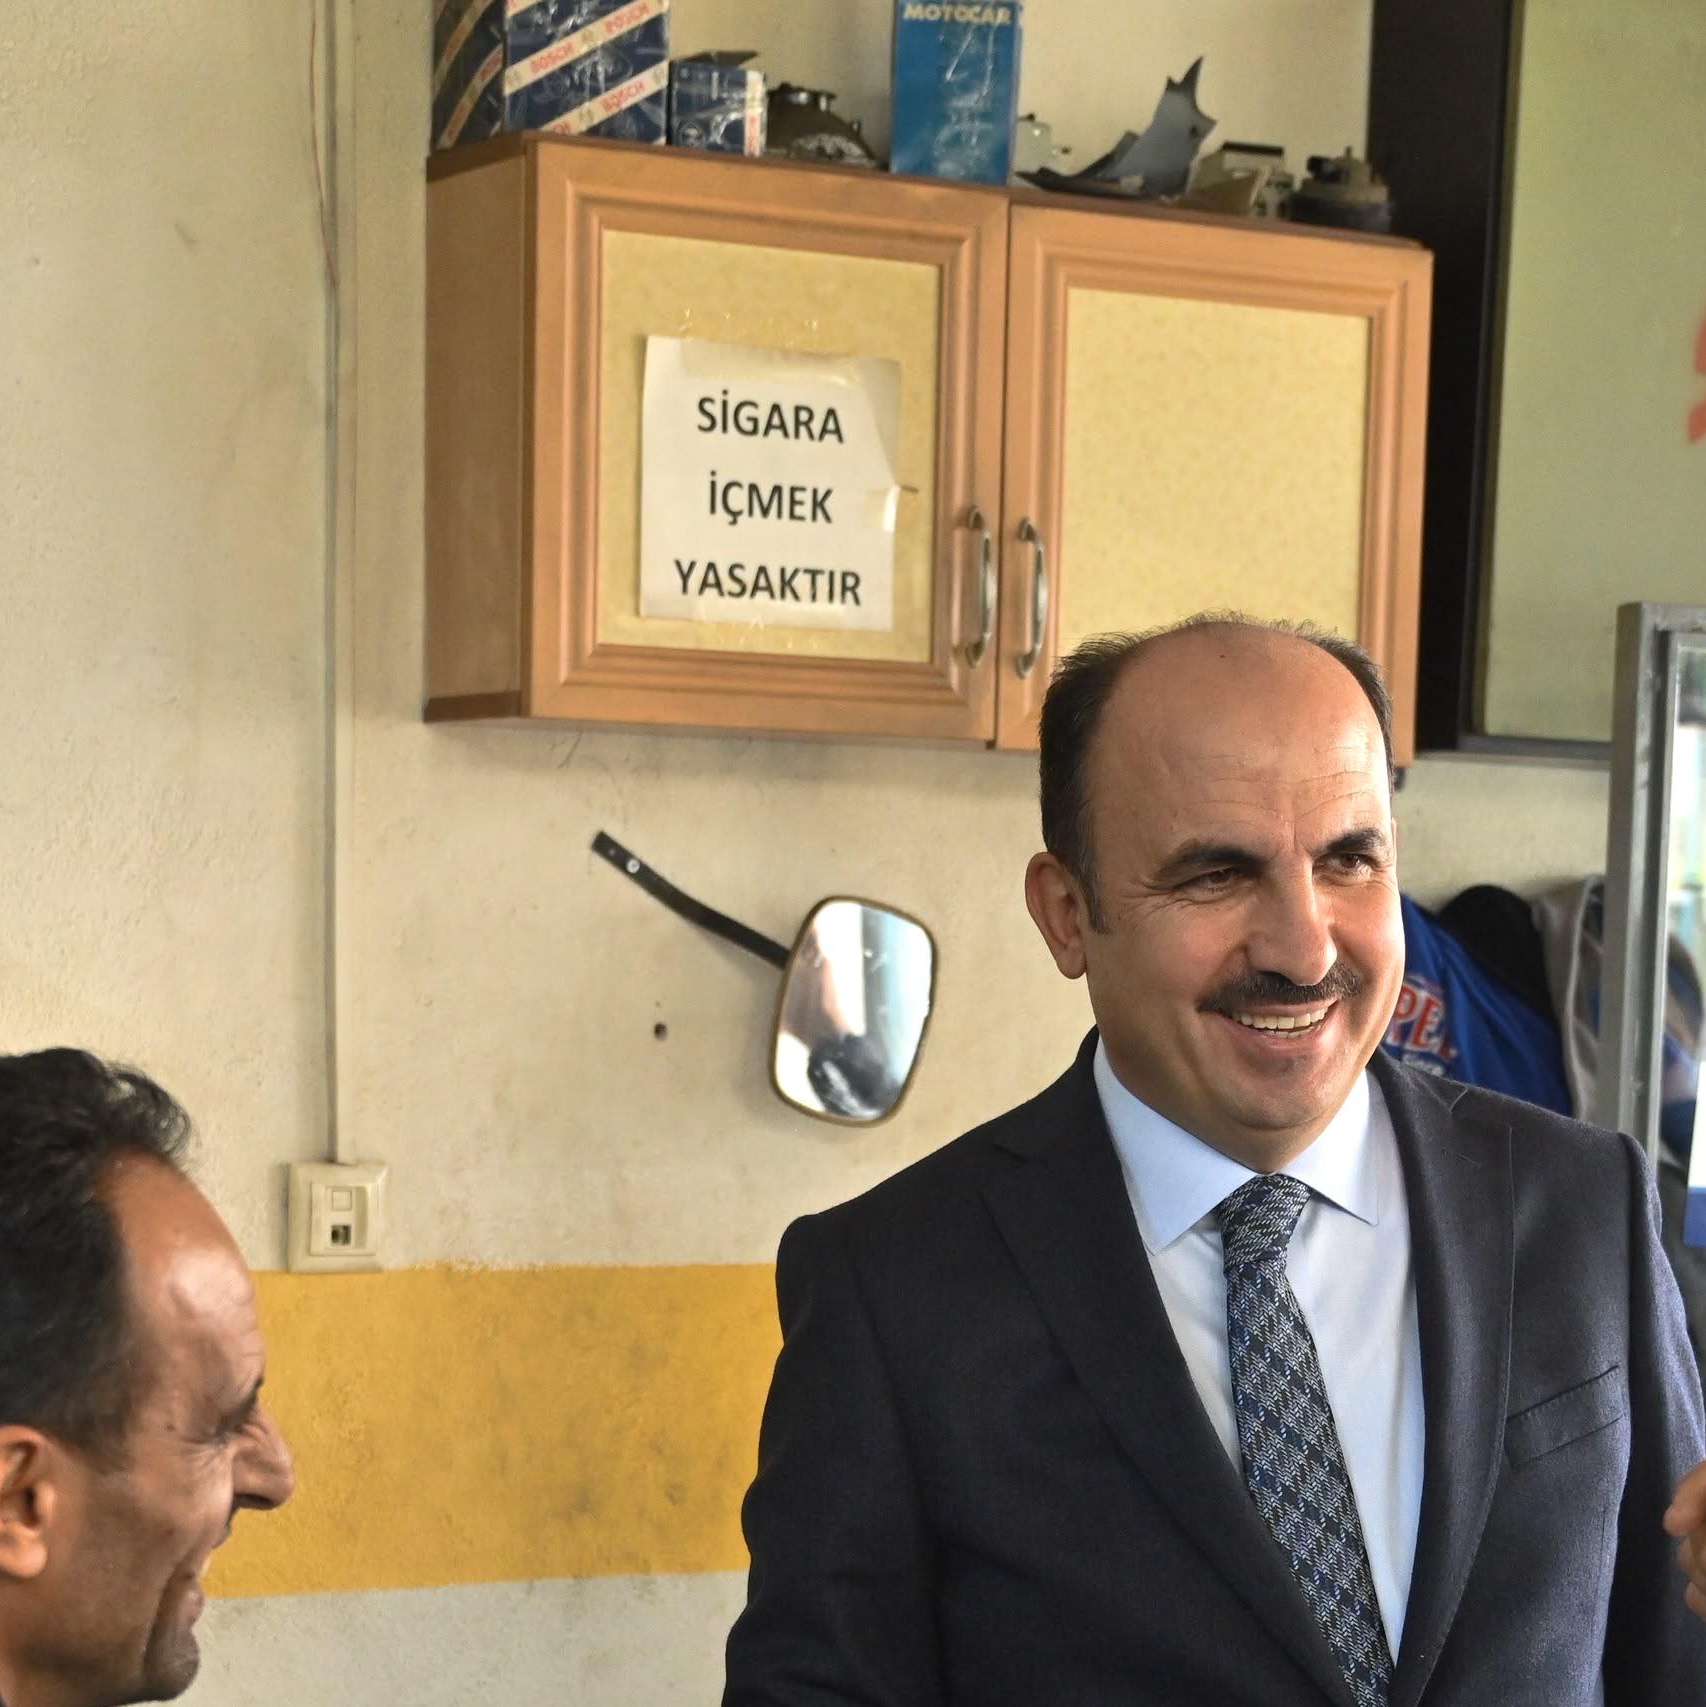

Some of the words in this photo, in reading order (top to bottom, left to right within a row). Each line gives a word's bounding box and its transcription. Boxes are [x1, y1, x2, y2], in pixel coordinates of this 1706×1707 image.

[696, 388, 845, 444] SİGARA
[709, 470, 834, 526] İÇMEK
[674, 558, 862, 607] YASAKTIR
